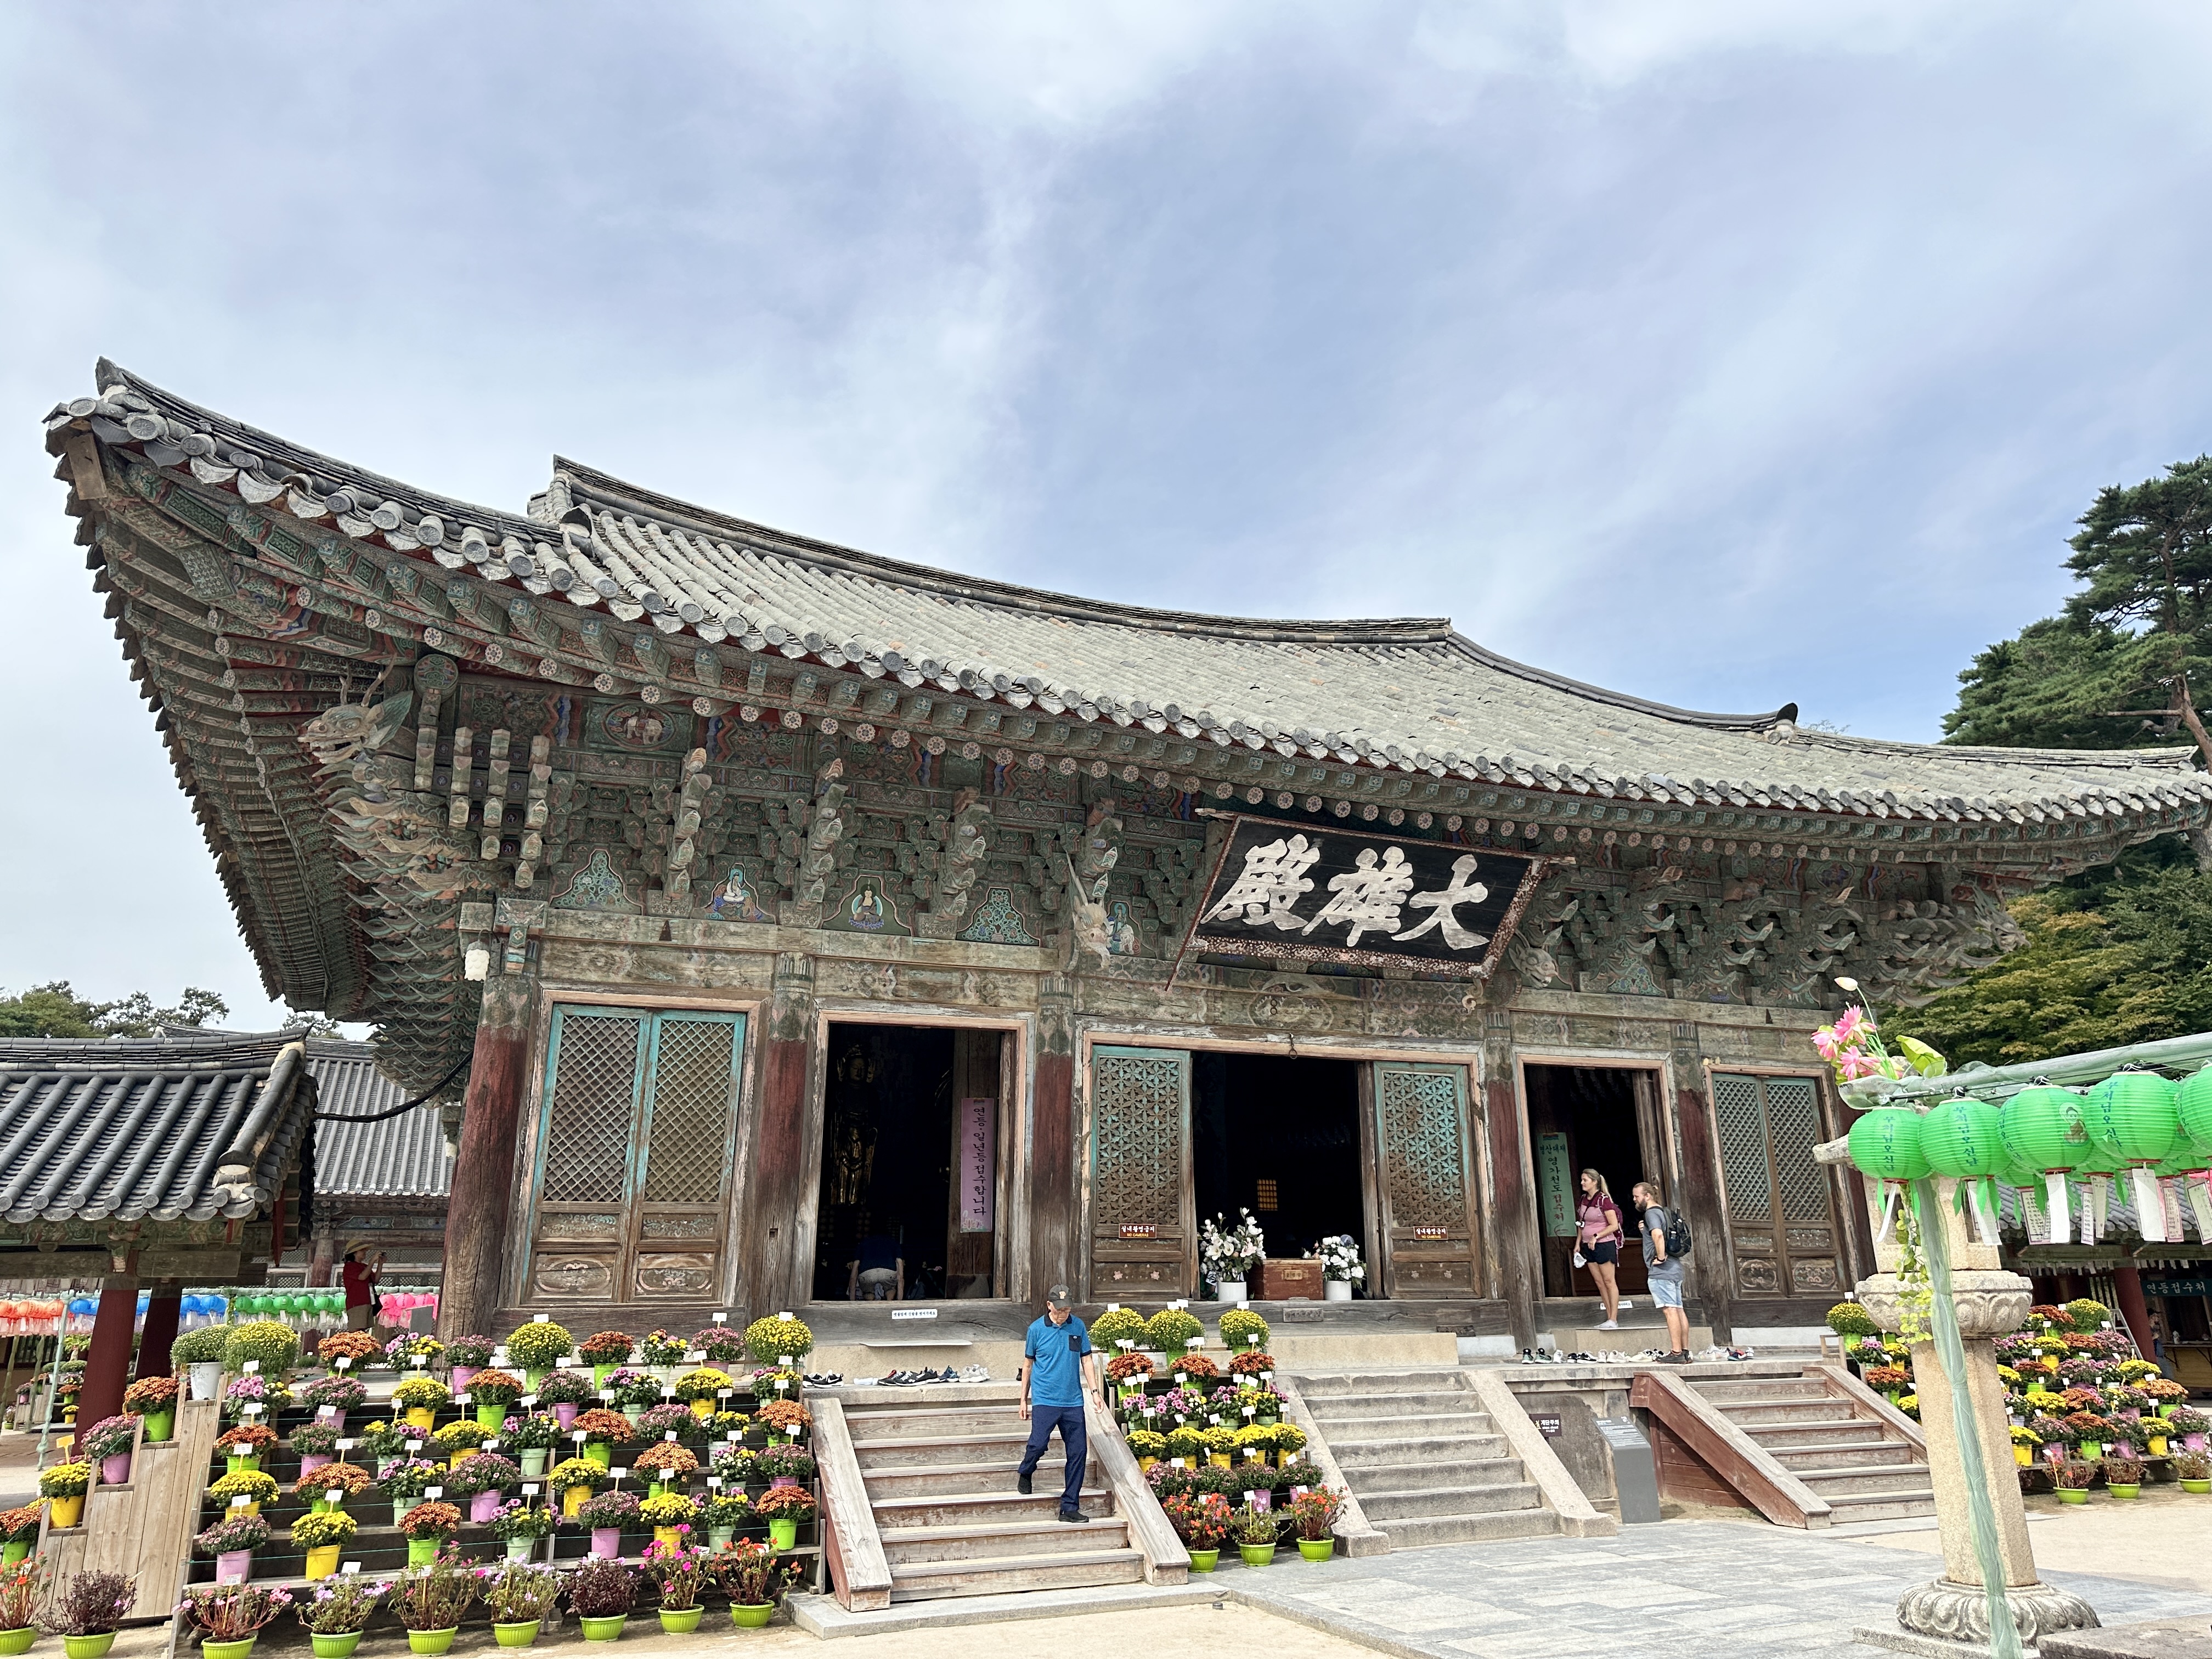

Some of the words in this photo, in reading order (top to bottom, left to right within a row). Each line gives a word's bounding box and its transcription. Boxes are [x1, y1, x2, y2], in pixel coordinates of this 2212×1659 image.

[1882, 1116, 1896, 1172] 부처님오신날
[1953, 1106, 1979, 1166] 부처님오신날
[972, 1164, 987, 1216] 접수합니다
[1548, 1156, 1562, 1192] 영가천도
[2146, 1281, 2205, 1294] 연등접수처
